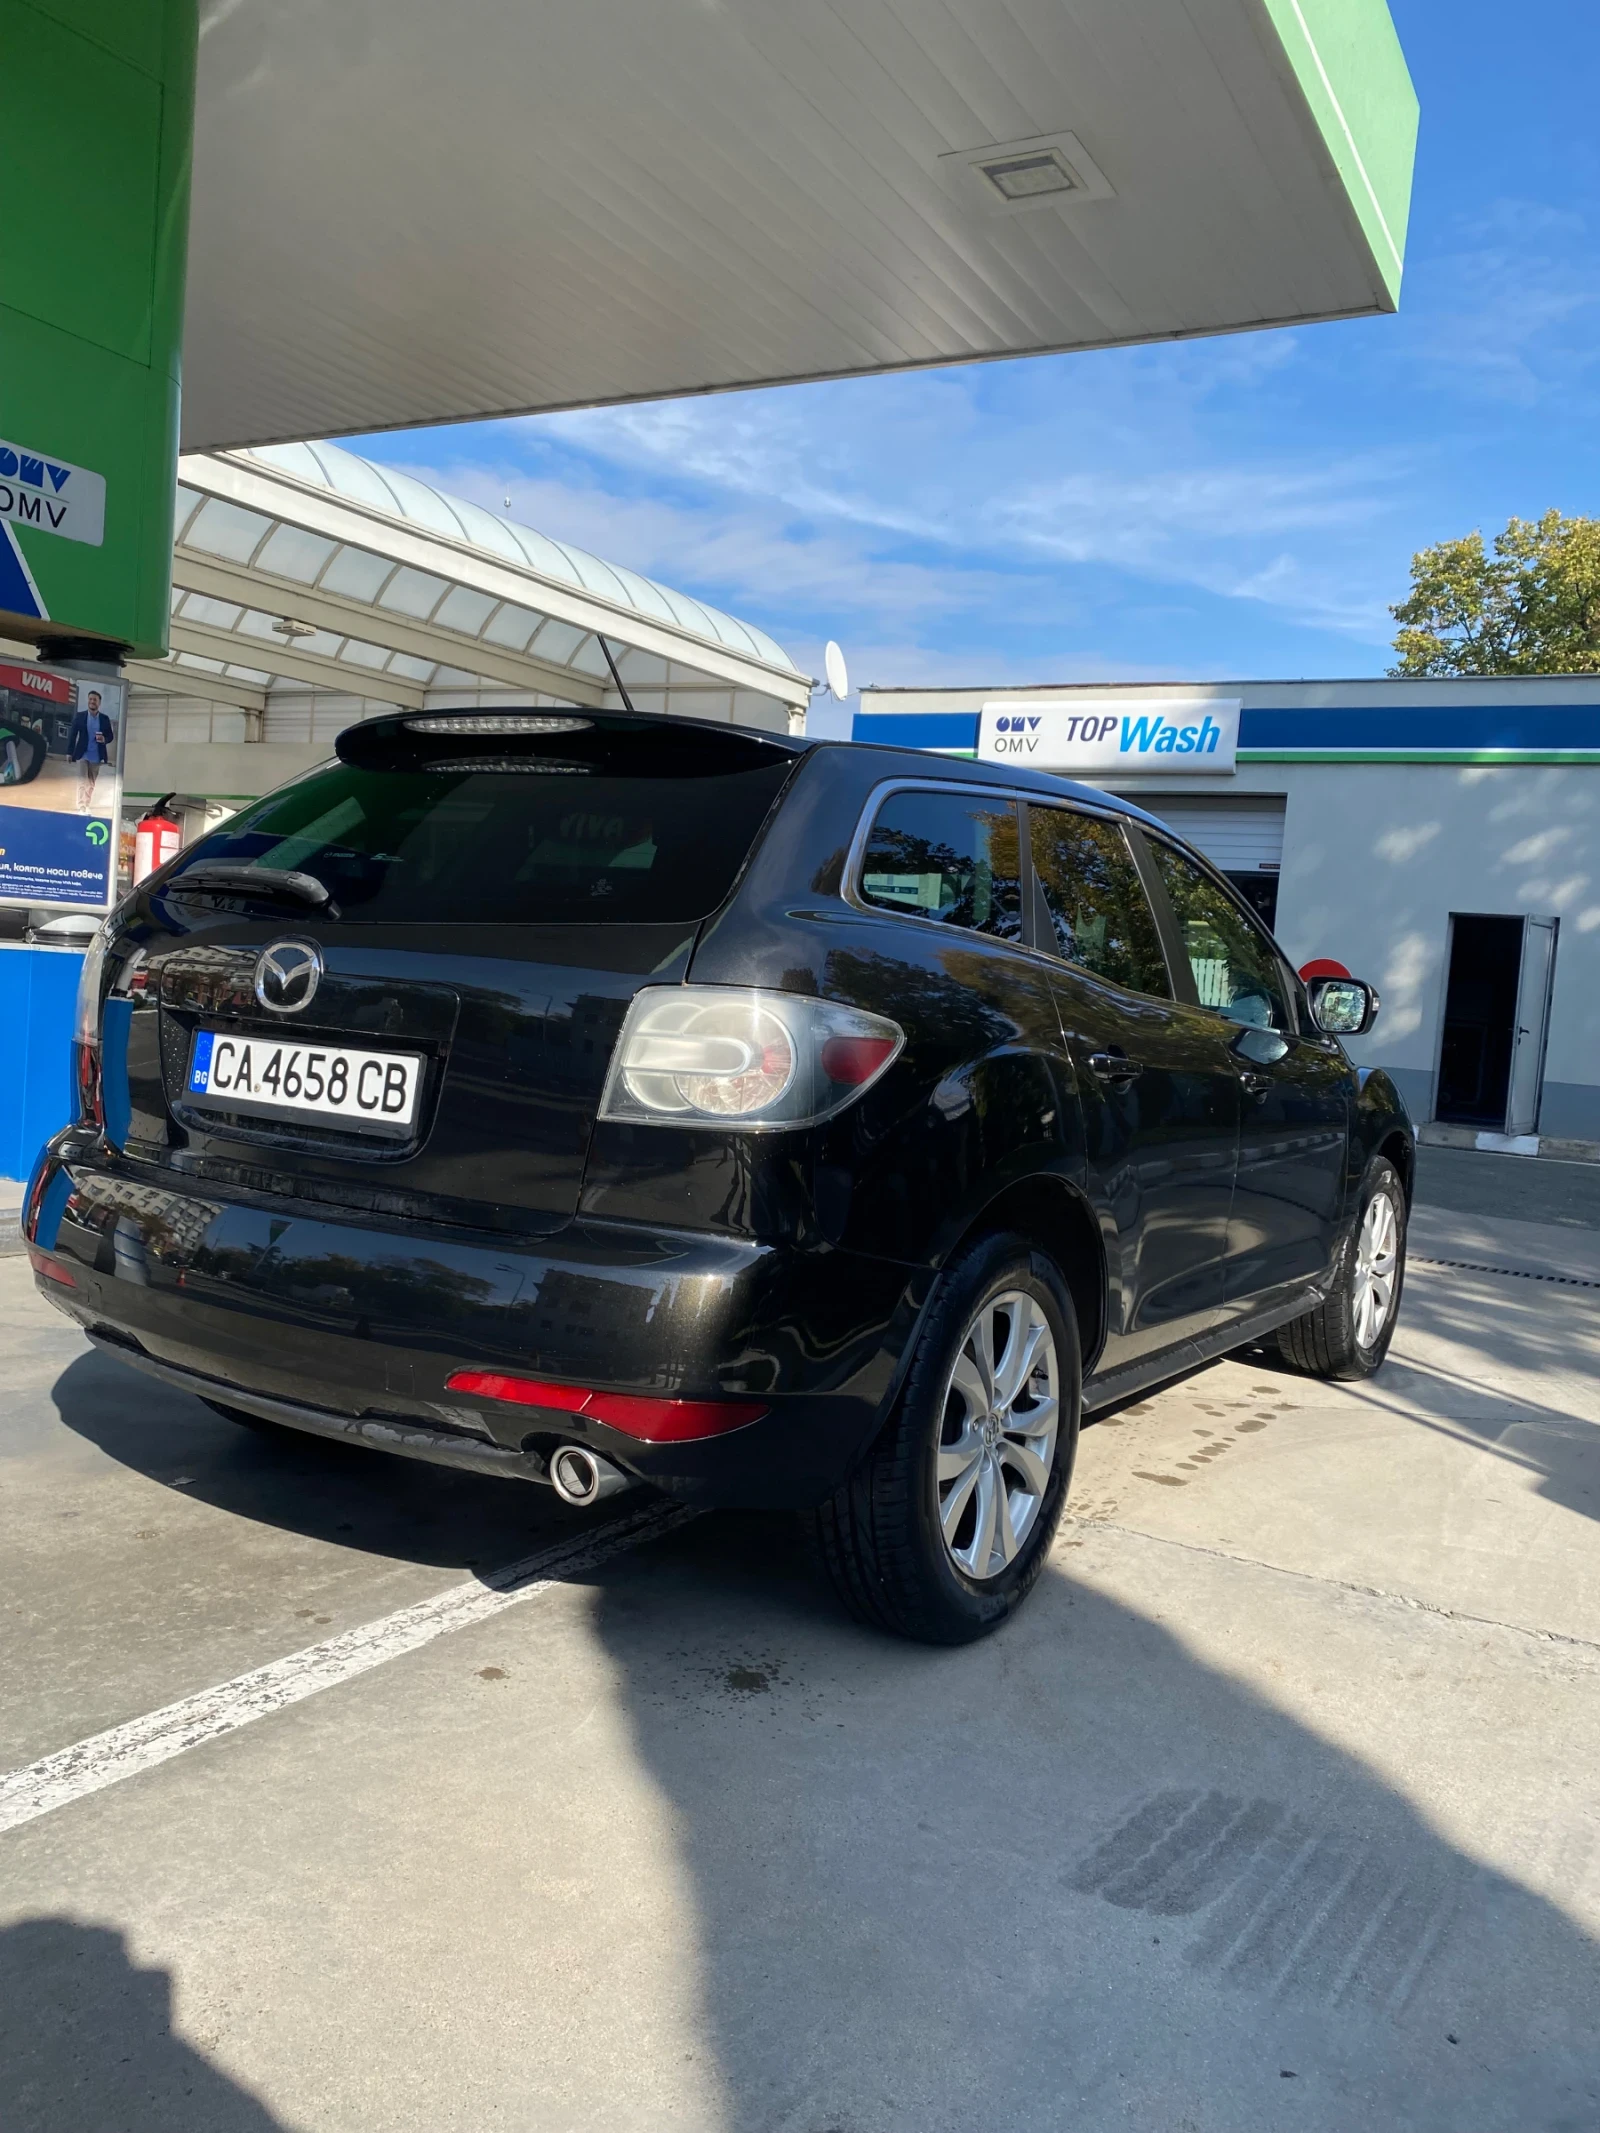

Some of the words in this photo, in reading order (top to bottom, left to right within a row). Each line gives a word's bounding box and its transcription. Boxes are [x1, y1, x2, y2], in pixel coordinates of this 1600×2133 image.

[0, 485, 67, 528] OMV
[21, 671, 53, 695] VIVA
[994, 738, 1039, 753] OMV
[1066, 716, 1118, 742] TOP
[1119, 716, 1221, 753] Wash
[14, 863, 45, 874] която
[47, 868, 69, 877] носи
[71, 870, 103, 880] повече
[194, 1070, 207, 1085] BG
[213, 1041, 253, 1093] CA
[262, 1048, 349, 1106] 4658
[356, 1059, 408, 1113] CB
